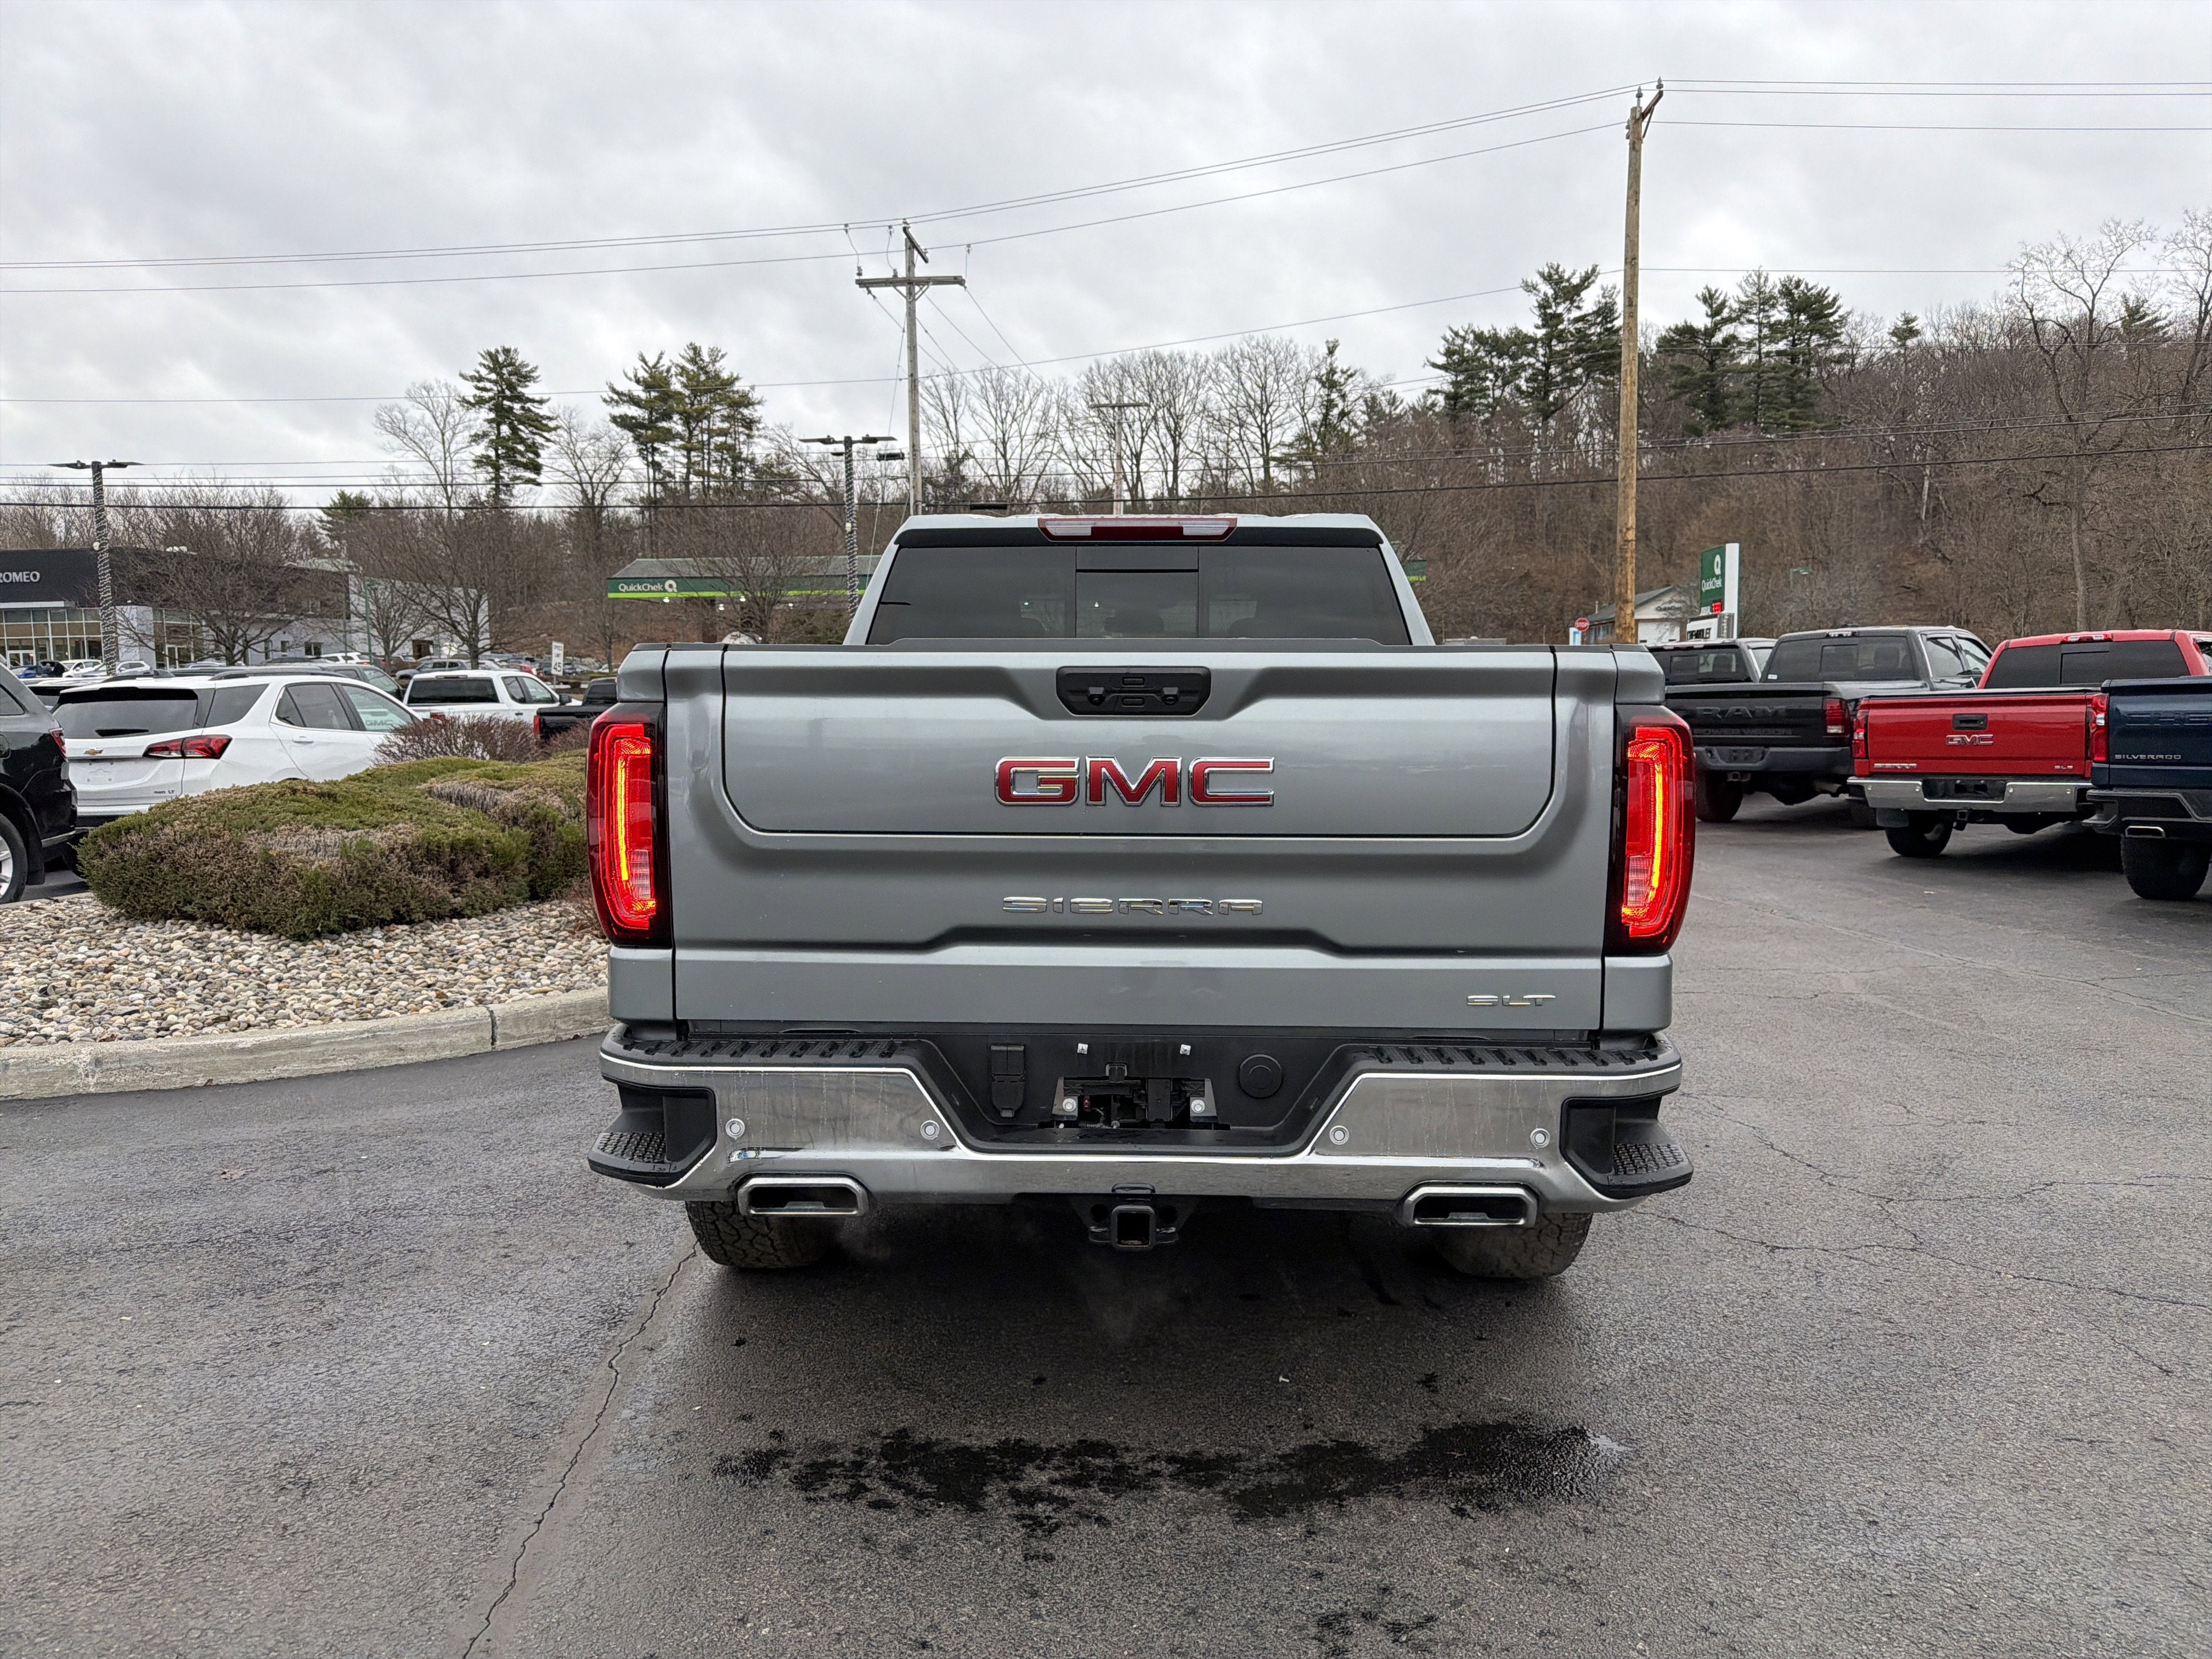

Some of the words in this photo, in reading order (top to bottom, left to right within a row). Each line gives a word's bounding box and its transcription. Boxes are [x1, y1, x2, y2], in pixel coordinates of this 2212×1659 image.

[618, 583, 663, 592] QuickChek
[1701, 577, 1722, 592] QuickChek
[554, 662, 561, 673] 45
[1696, 706, 1788, 719] RAM
[1946, 734, 1994, 746] GMC
[995, 756, 1275, 807] GMC
[1002, 896, 1263, 916] SIERRA
[1467, 995, 1556, 1007] SLT
